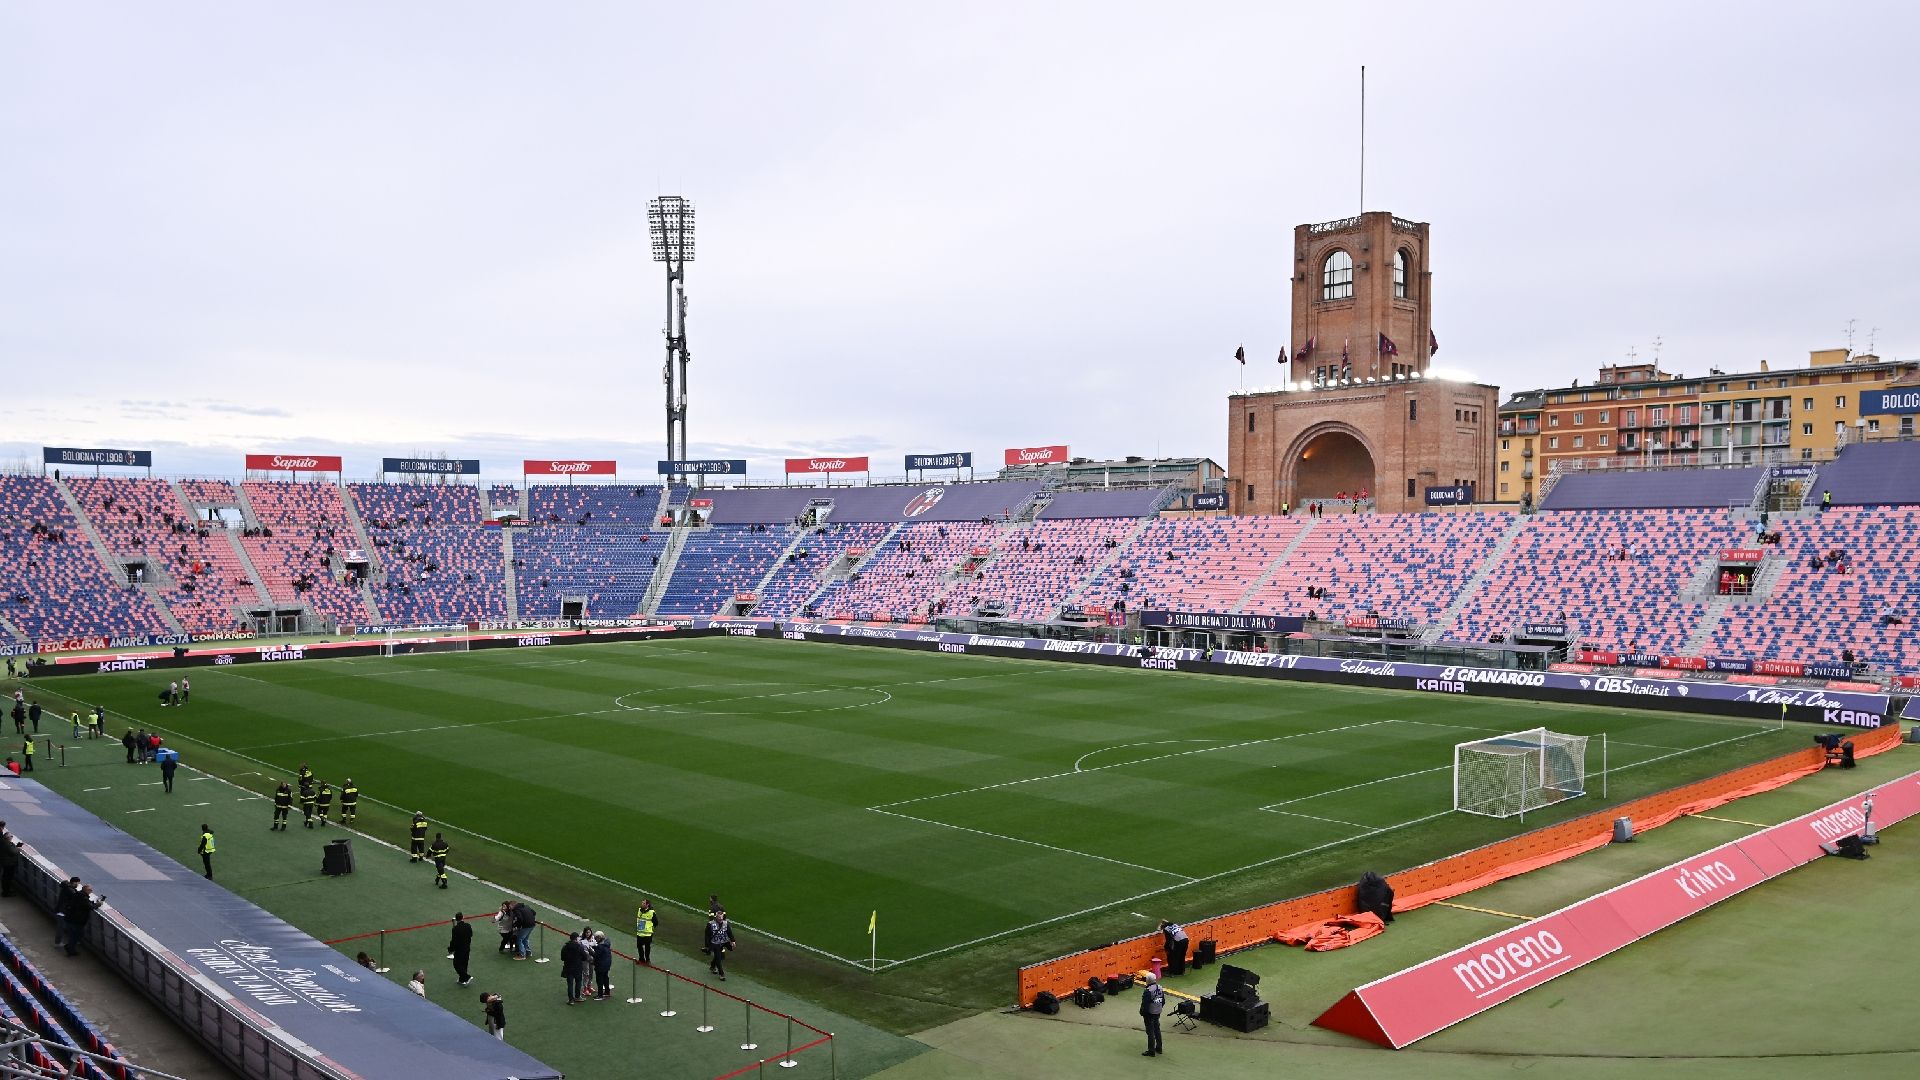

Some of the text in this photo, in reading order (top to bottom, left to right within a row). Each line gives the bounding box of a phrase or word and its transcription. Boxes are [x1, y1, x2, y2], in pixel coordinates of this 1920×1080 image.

[1882, 393, 1920, 409] BOLOG
[62, 450, 123, 463] BOLOGNA FC 1909
[271, 456, 318, 470] Saputo
[1019, 449, 1053, 464] Saputo
[549, 461, 592, 474] Saputo
[808, 459, 846, 472] Saputo
[1175, 614, 1200, 625] STADIO
[1201, 615, 1229, 627] RENATO
[69, 638, 106, 651] CURVA
[110, 633, 190, 648] ANDREA COSTA
[518, 637, 551, 647] KAMA
[938, 642, 965, 653] KAMA
[978, 638, 1025, 649] NEW HOLLAND
[1044, 640, 1103, 654] UNIBET TV
[262, 650, 303, 661] KAMA
[1225, 650, 1301, 668] UNIBET TV
[100, 660, 146, 671] KAMA
[1141, 658, 1176, 670] KAMA
[1340, 659, 1395, 677] Selenella
[1765, 663, 1800, 674] ROMAGNA
[1458, 668, 1545, 686] GRANAROLO
[1814, 667, 1850, 677] SVIZZERA
[1416, 678, 1465, 693] KAMA
[1755, 689, 1803, 705] Chef
[1805, 692, 1843, 708] Casa
[1824, 709, 1881, 728] KAMA
[1810, 806, 1866, 840] moreno
[1452, 930, 1563, 993] moreno
[187, 948, 298, 1006] GARDEN PLATINO
